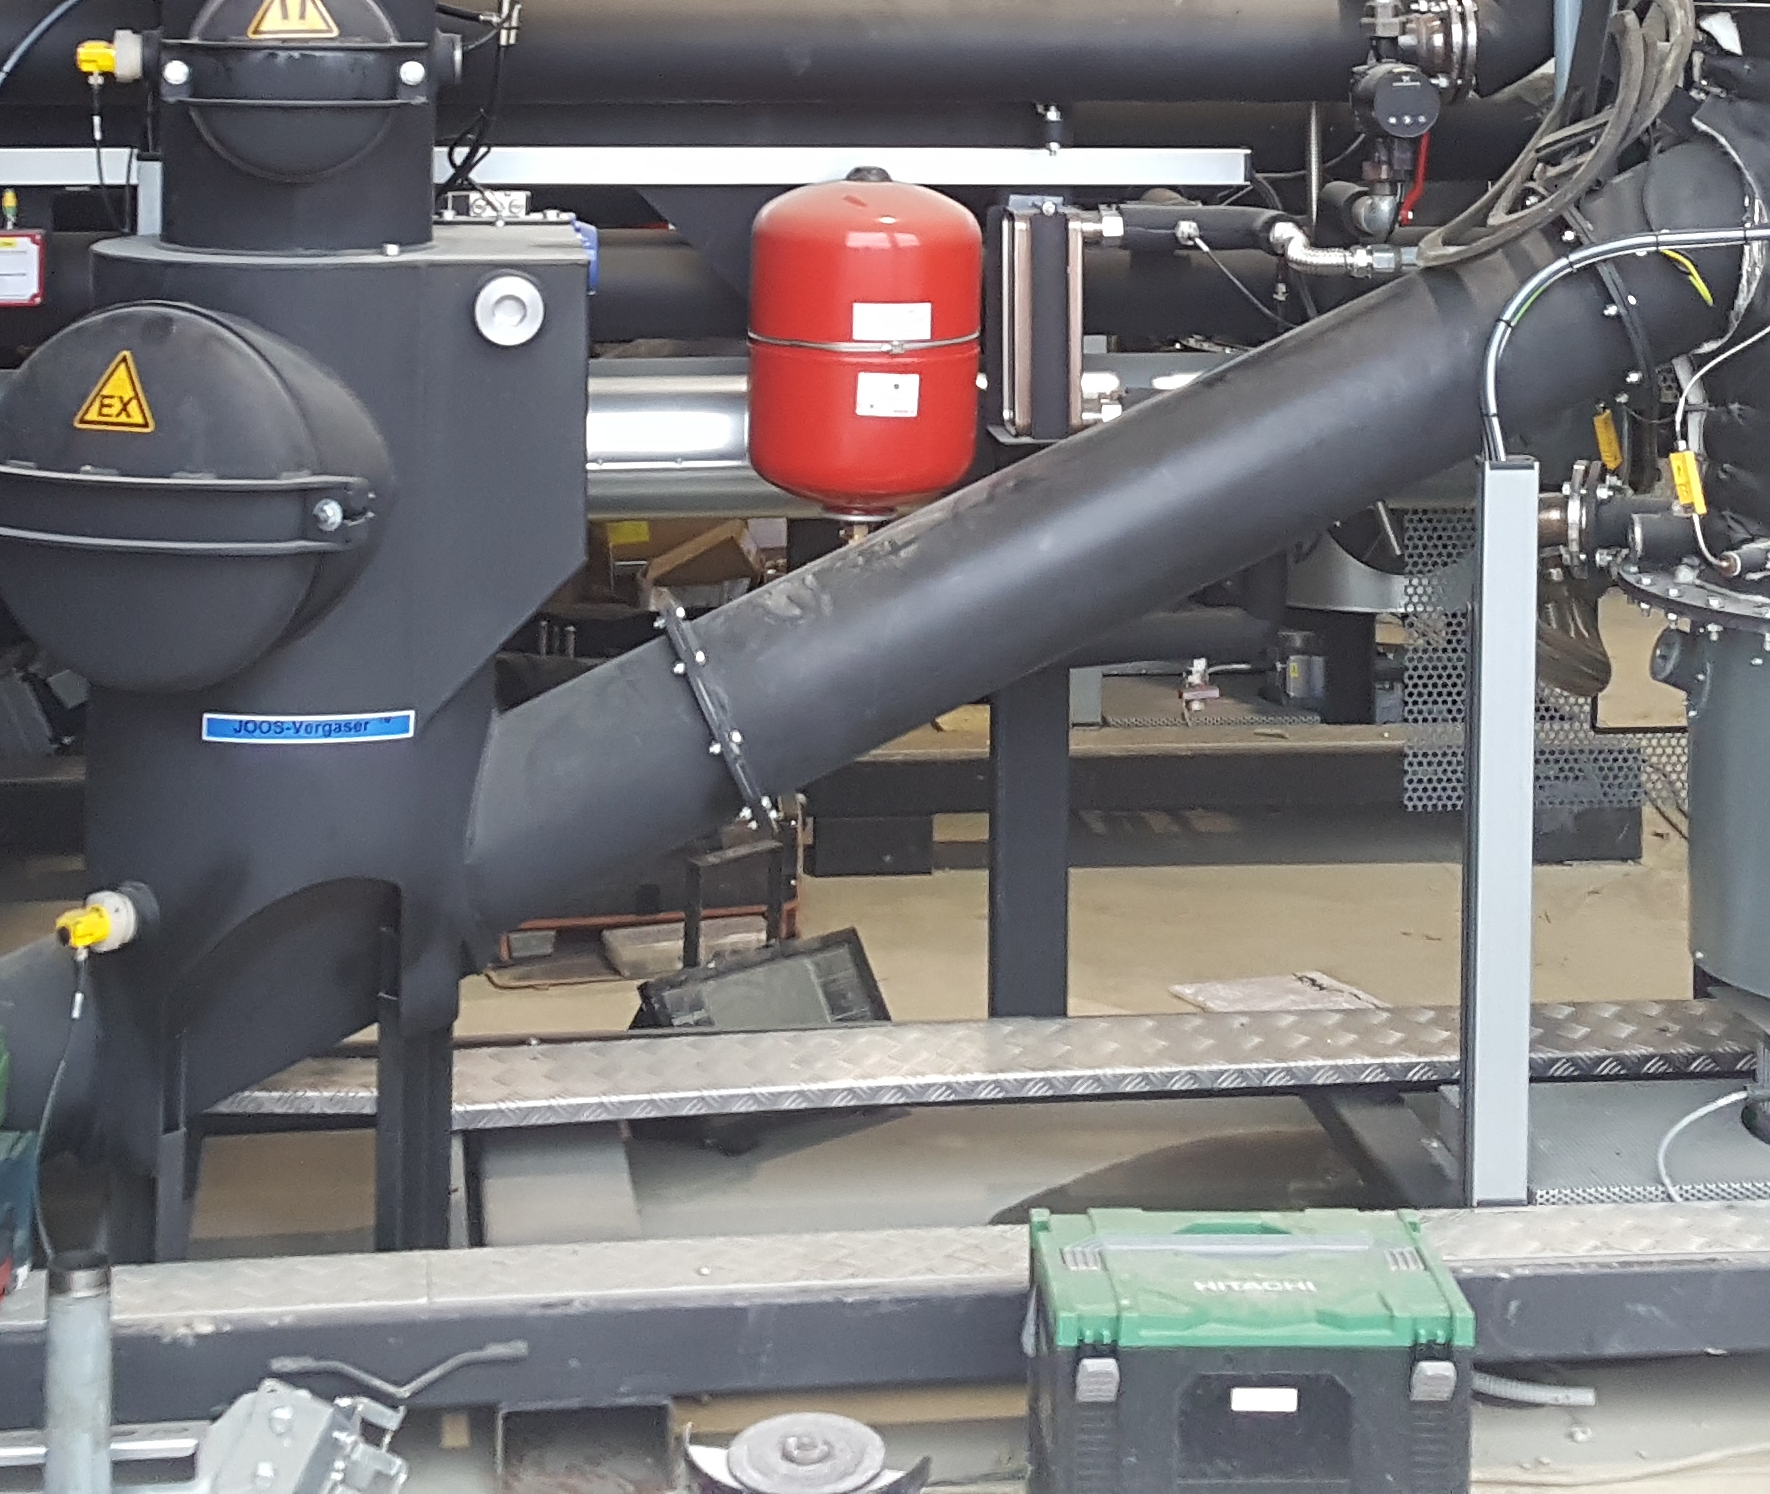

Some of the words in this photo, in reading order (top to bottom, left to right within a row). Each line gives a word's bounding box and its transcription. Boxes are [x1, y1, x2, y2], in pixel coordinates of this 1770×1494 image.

[97, 395, 136, 418] EX
[233, 719, 370, 738] JOOS-Vergaser
[1193, 1280, 1317, 1293] HITACHI
